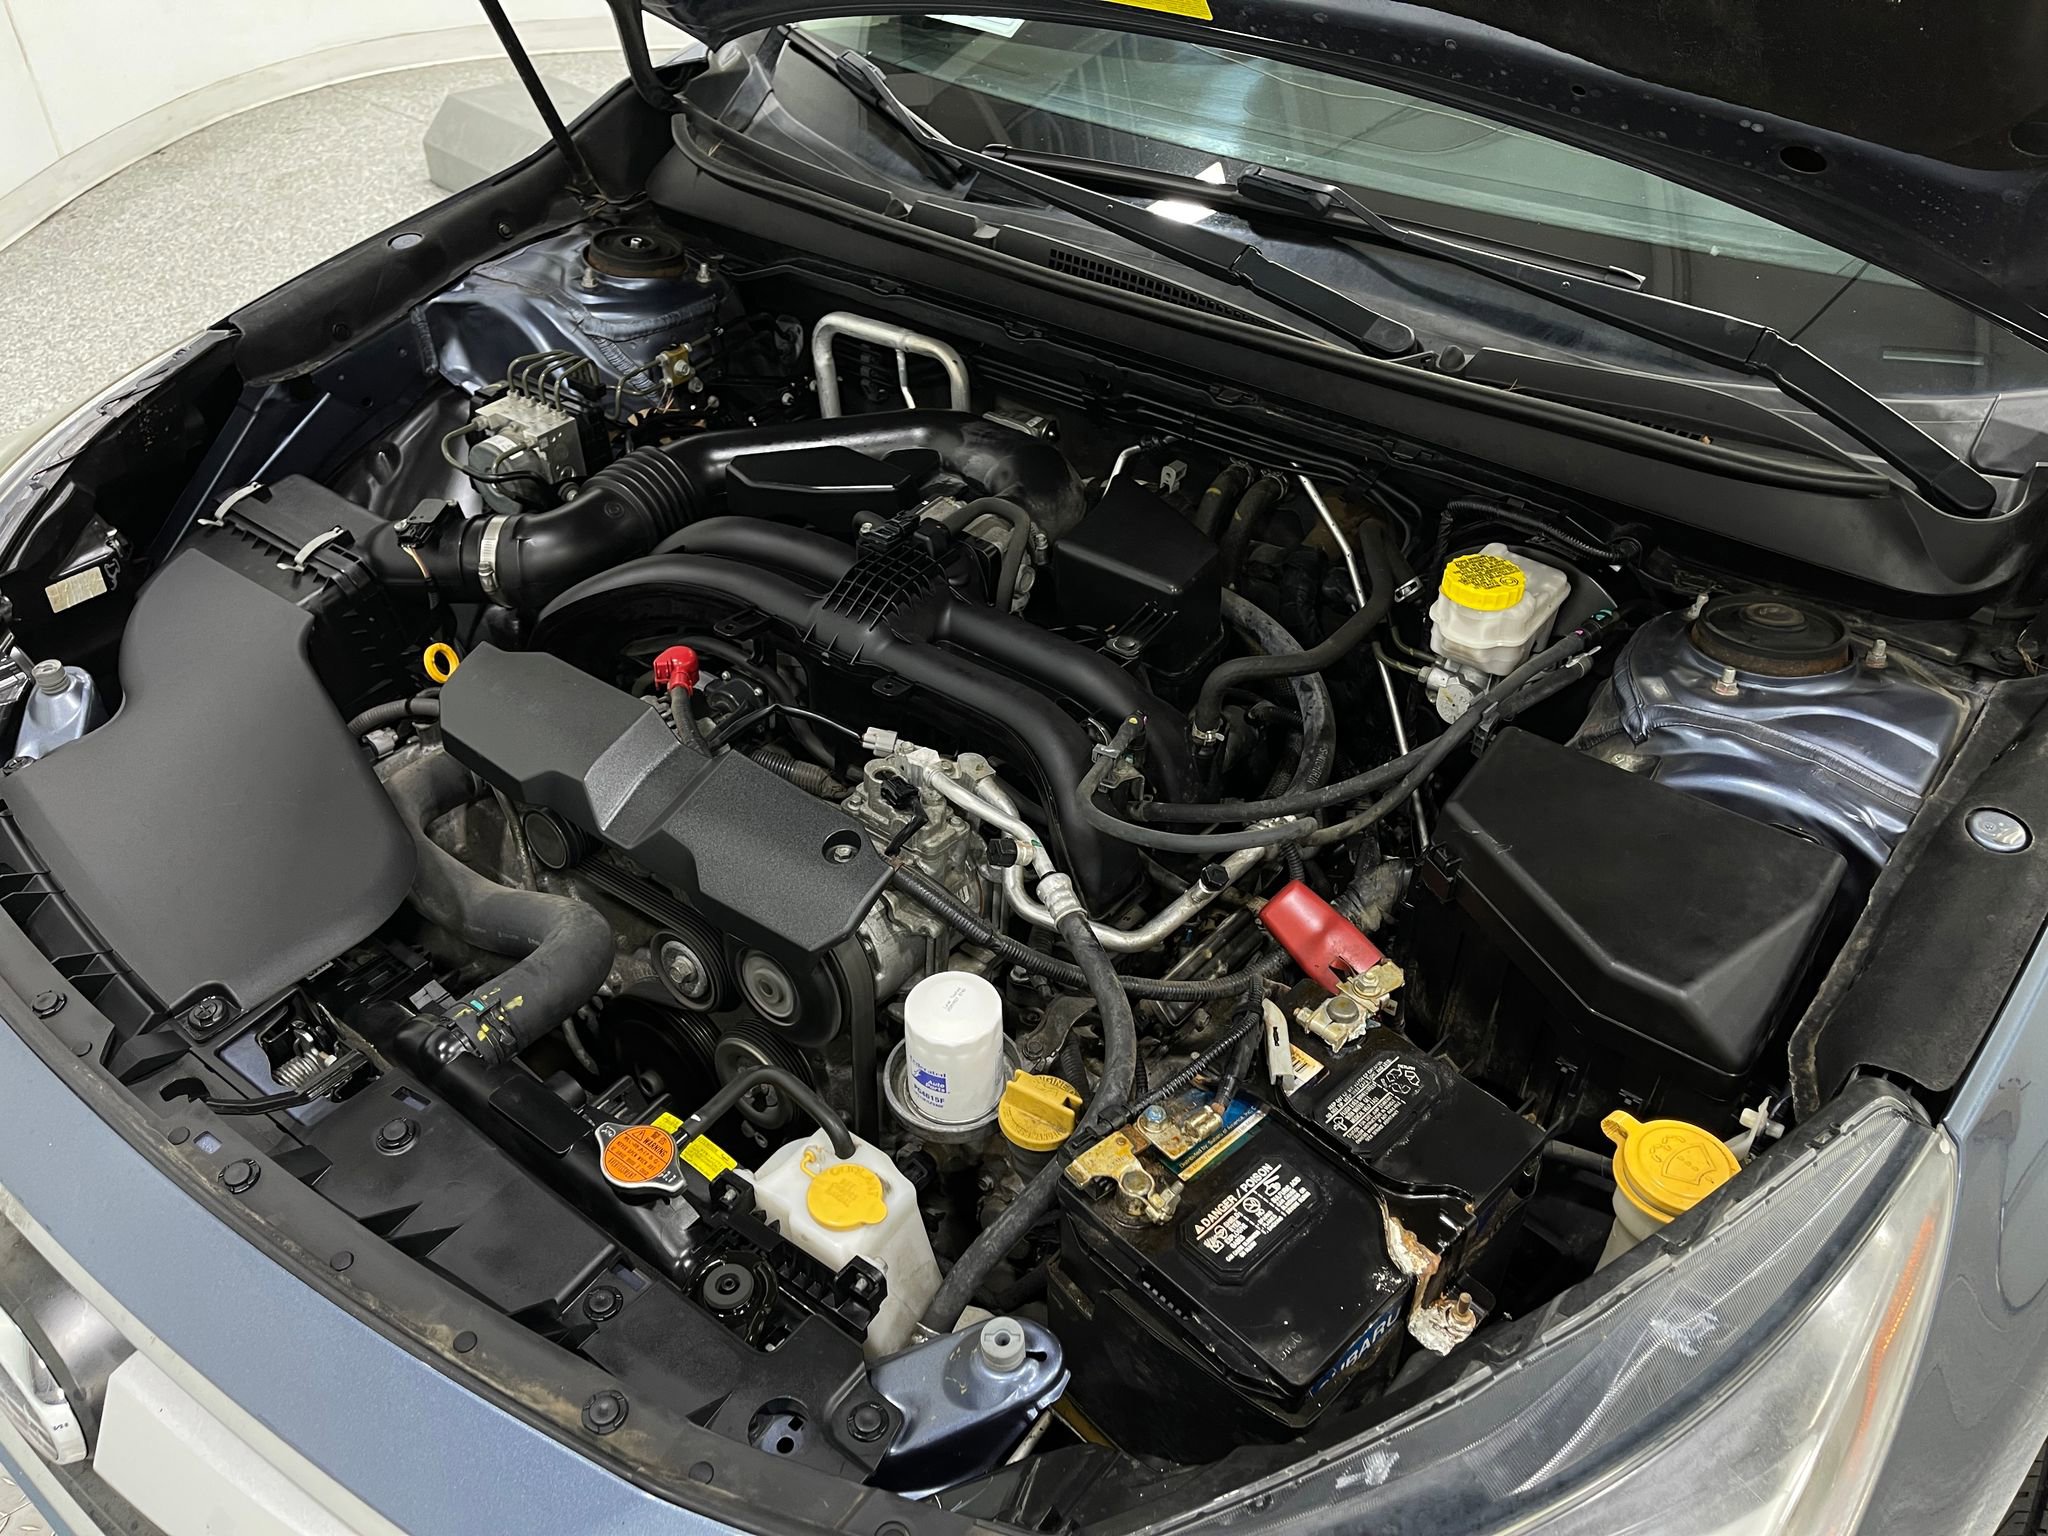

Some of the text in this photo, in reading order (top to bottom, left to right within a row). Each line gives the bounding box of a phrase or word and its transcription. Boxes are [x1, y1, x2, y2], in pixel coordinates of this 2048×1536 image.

[925, 1082, 946, 1092] Parts
[928, 1080, 945, 1088] Auto
[1037, 1076, 1069, 1092] NGINE
[642, 1137, 667, 1158] WARNING
[1201, 1195, 1238, 1228] DANGER
[1240, 1162, 1273, 1193] POISON
